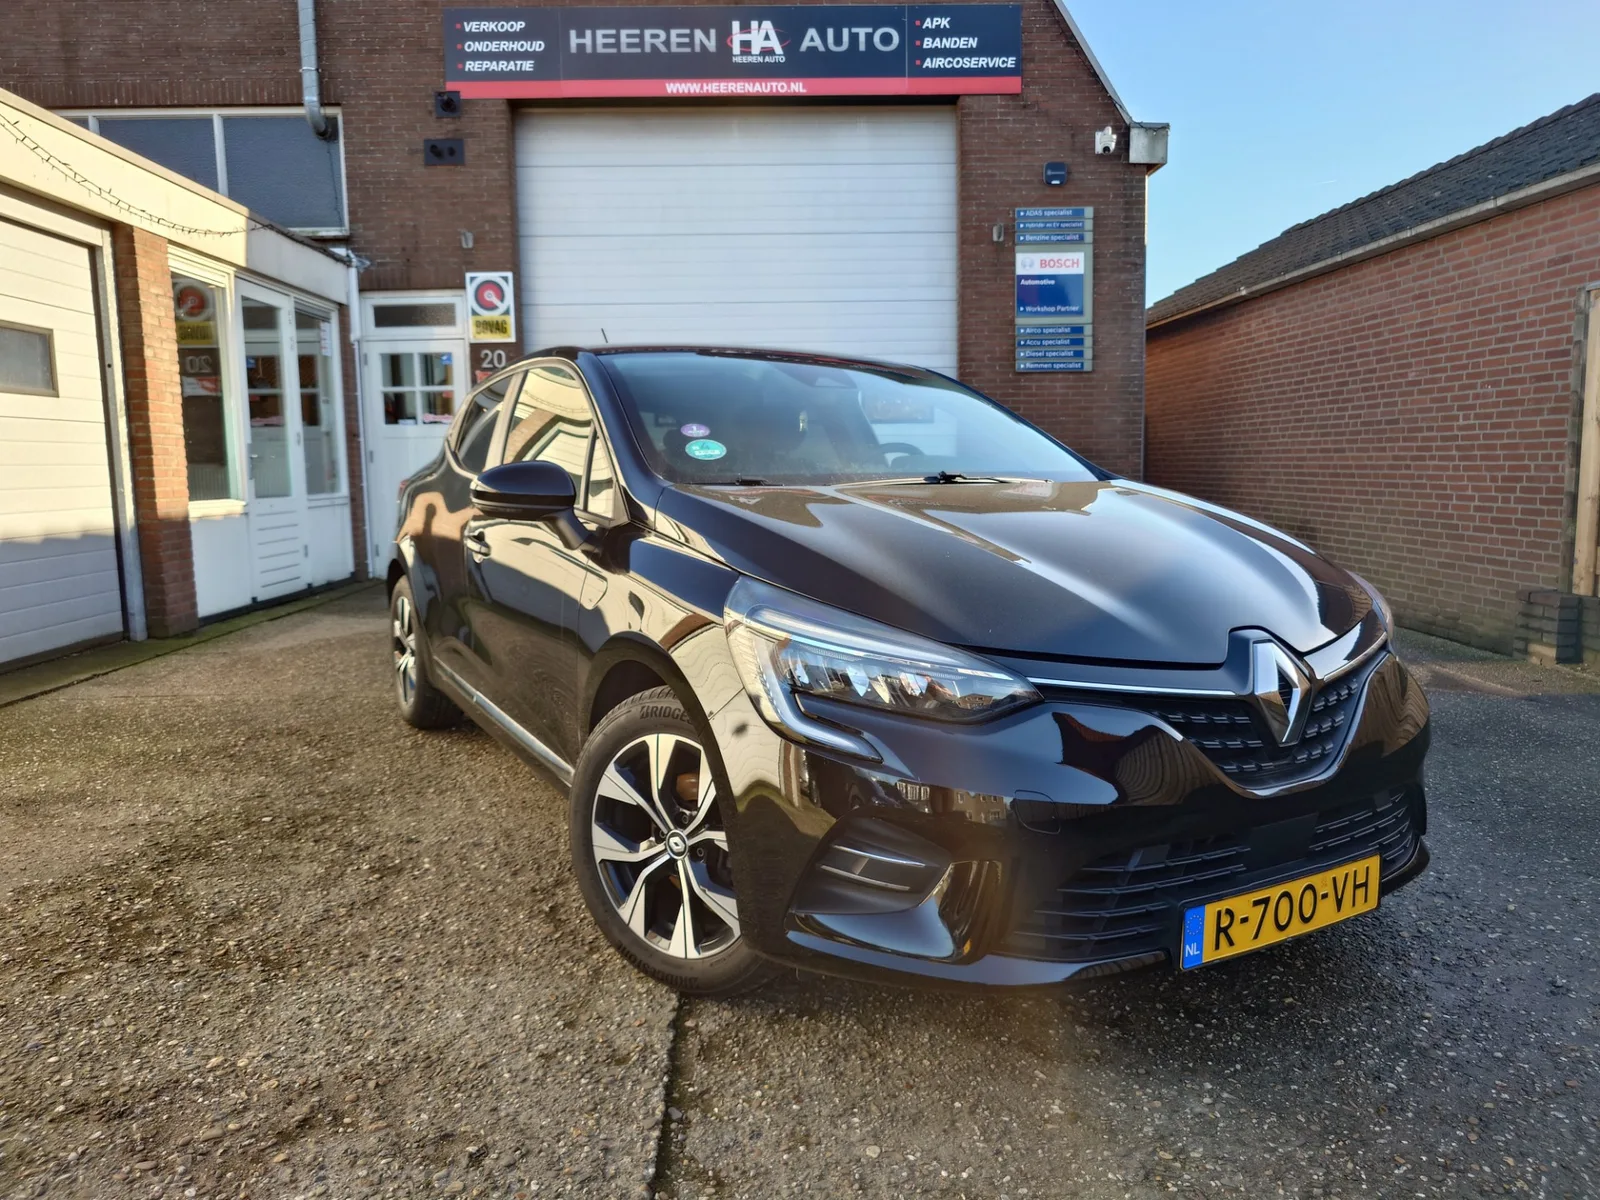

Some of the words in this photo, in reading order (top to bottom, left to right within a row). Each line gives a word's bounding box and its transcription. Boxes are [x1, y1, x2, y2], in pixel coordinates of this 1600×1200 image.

[463, 21, 525, 33] VERKOOP
[923, 17, 951, 29] APK
[569, 28, 718, 53] HEEREN
[799, 27, 900, 52] AUTO
[732, 20, 784, 55] HA
[923, 37, 978, 49] BANDEN
[464, 41, 545, 52] ONDERHOUD
[732, 55, 764, 63] HEEREN
[764, 55, 786, 63] AUTO
[923, 57, 1016, 69] AIRCOSERVICE
[465, 60, 535, 72] REPARATIE
[665, 82, 807, 94] WWW.HEERENAUTO.NL
[1040, 258, 1079, 269] BOSCH
[1025, 305, 1055, 313] Workshop
[481, 349, 506, 368] 20
[1214, 865, 1369, 951] R-700-VH
[1185, 941, 1200, 957] NL
